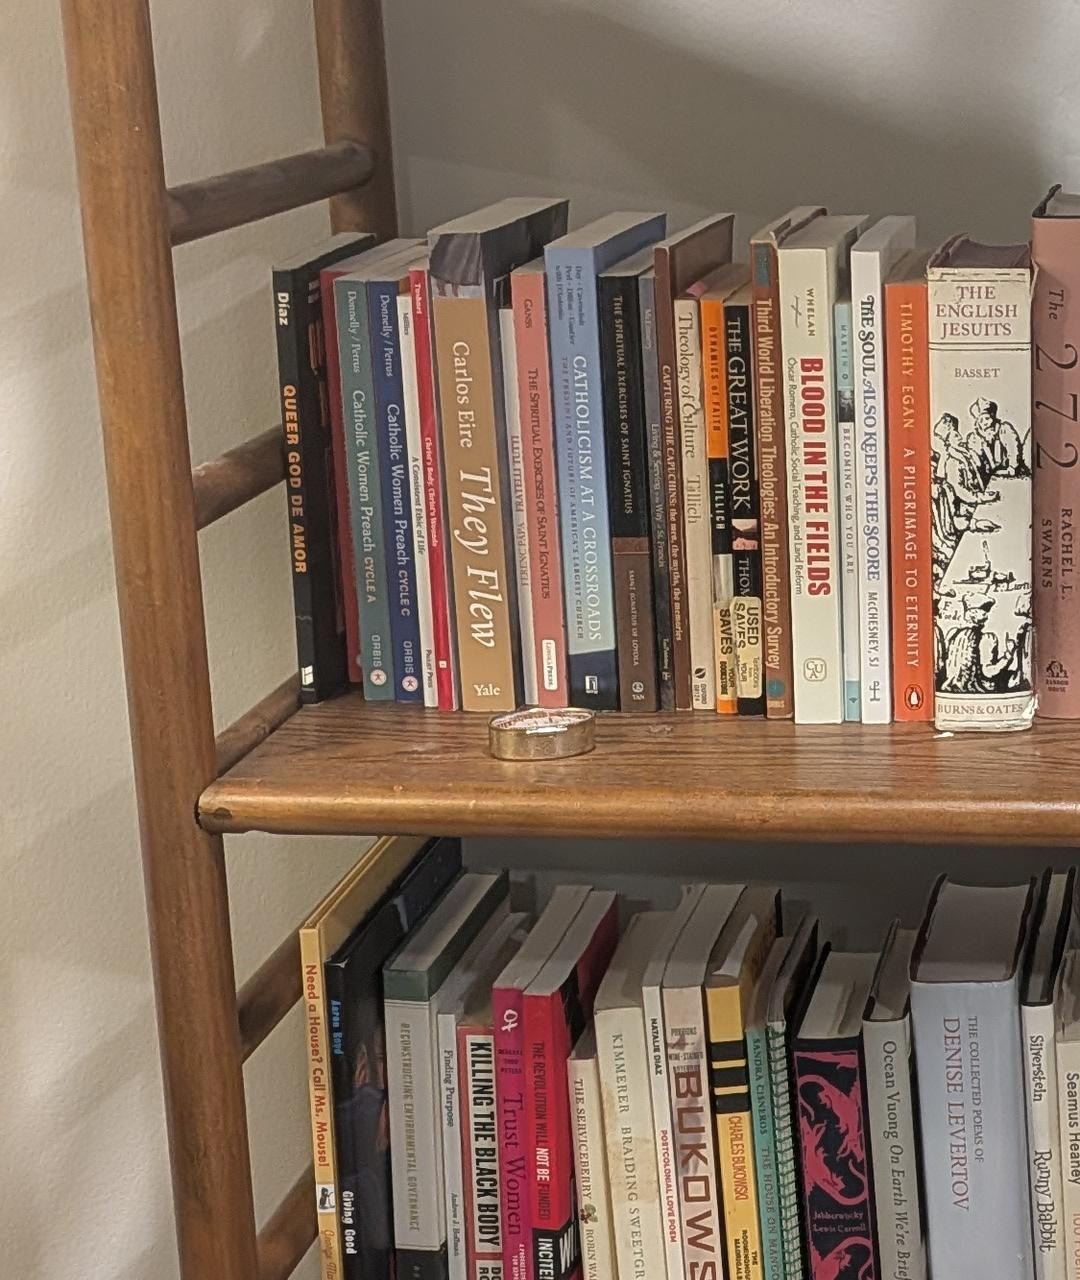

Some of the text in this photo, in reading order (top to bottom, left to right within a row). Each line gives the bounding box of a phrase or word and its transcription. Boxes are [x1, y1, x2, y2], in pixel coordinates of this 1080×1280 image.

[806, 287, 816, 338] WHELAN
[936, 303, 1018, 319] ENGLISH
[956, 286, 996, 300] THE
[1048, 289, 1063, 321] The
[941, 321, 1012, 338] JESUITS
[954, 367, 999, 380] BASSET
[277, 292, 307, 574] Díaz QUEER GOD DE AMOR
[728, 317, 751, 511] THE GREAT WORK
[452, 341, 503, 648] Carlos Eire They Flew
[573, 356, 602, 641] CATHOLICISM AT A CROSSROADS
[800, 358, 831, 597] BLOOD IN THE FIELDS
[474, 683, 500, 698] Yale
[306, 964, 317, 1002] Need
[308, 1003, 317, 1012] a
[310, 1015, 322, 1063] House?
[313, 1068, 324, 1092] Call
[1067, 1071, 1079, 1128] Seamus
[612, 1033, 629, 1113] KIMMERER
[621, 1127, 638, 1202] BRAIDING
[944, 1017, 970, 1212] DENISE LEVERTOV
[317, 1122, 329, 1169] Mouse!
[471, 1042, 500, 1248] KILLING THE BLACK BODY
[342, 1191, 357, 1256] Giving Good
